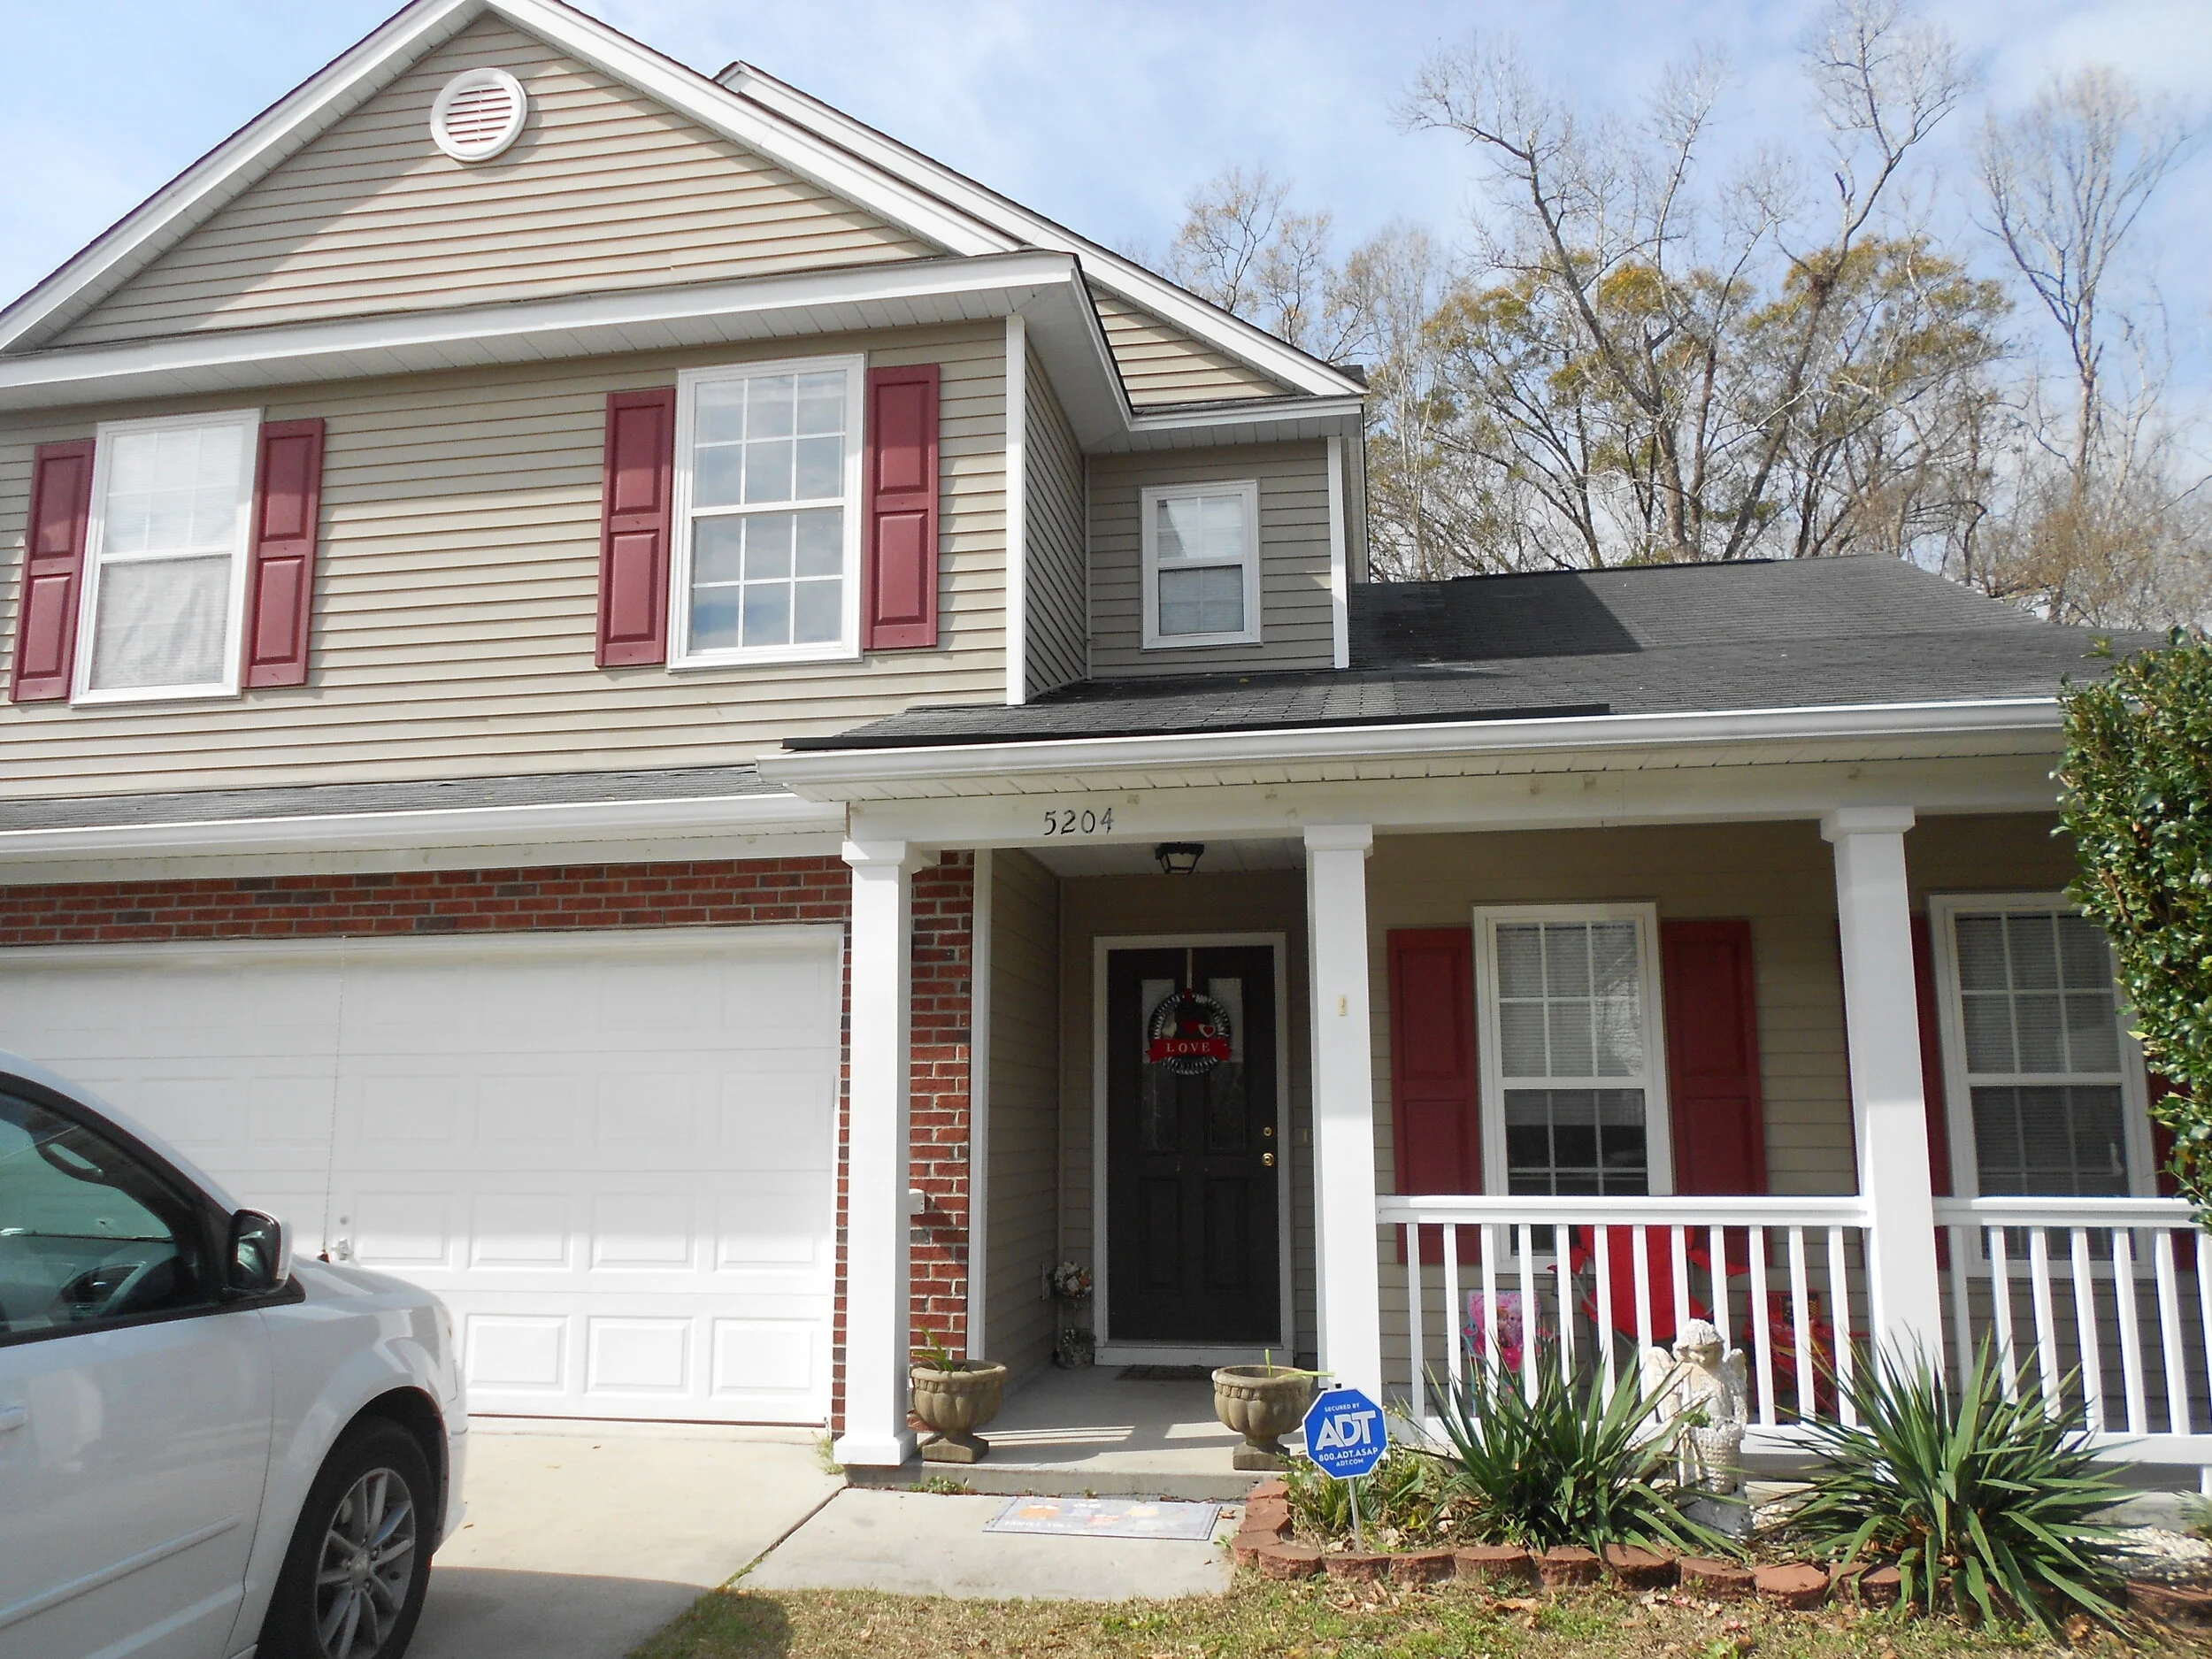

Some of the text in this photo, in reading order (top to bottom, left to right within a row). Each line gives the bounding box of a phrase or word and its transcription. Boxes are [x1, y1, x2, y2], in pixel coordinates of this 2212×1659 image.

[1043, 808, 1113, 835] 5204
[1166, 1042, 1210, 1054] LOVE
[1324, 1403, 1351, 1412] SECURED
[1315, 1409, 1377, 1451] ADT
